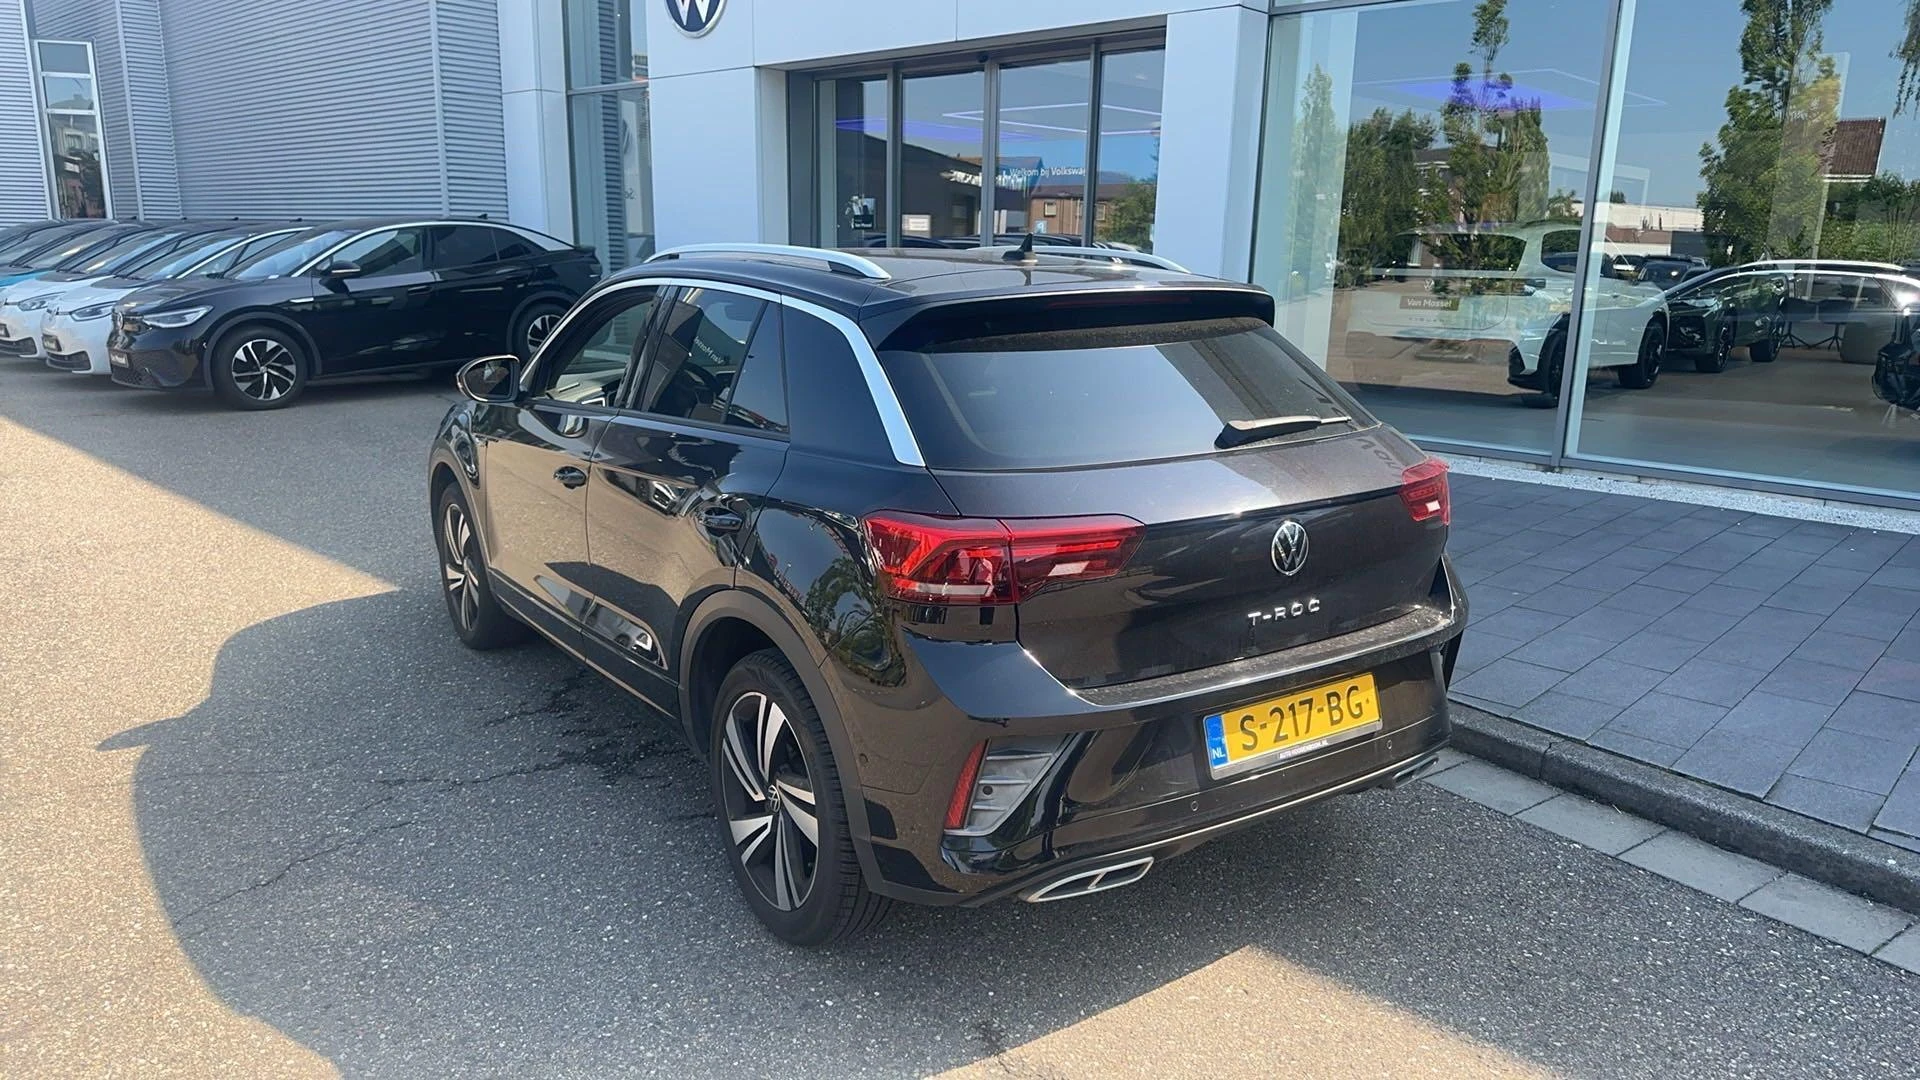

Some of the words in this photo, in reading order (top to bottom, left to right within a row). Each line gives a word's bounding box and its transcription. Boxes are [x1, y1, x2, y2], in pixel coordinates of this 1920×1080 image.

[1010, 168, 1039, 177] Welkom
[1407, 298, 1421, 307] Van
[1423, 298, 1452, 308] Mossel
[1247, 598, 1320, 627] T-ROC
[1240, 685, 1364, 751] S-217-BG
[1212, 747, 1225, 759] NL
